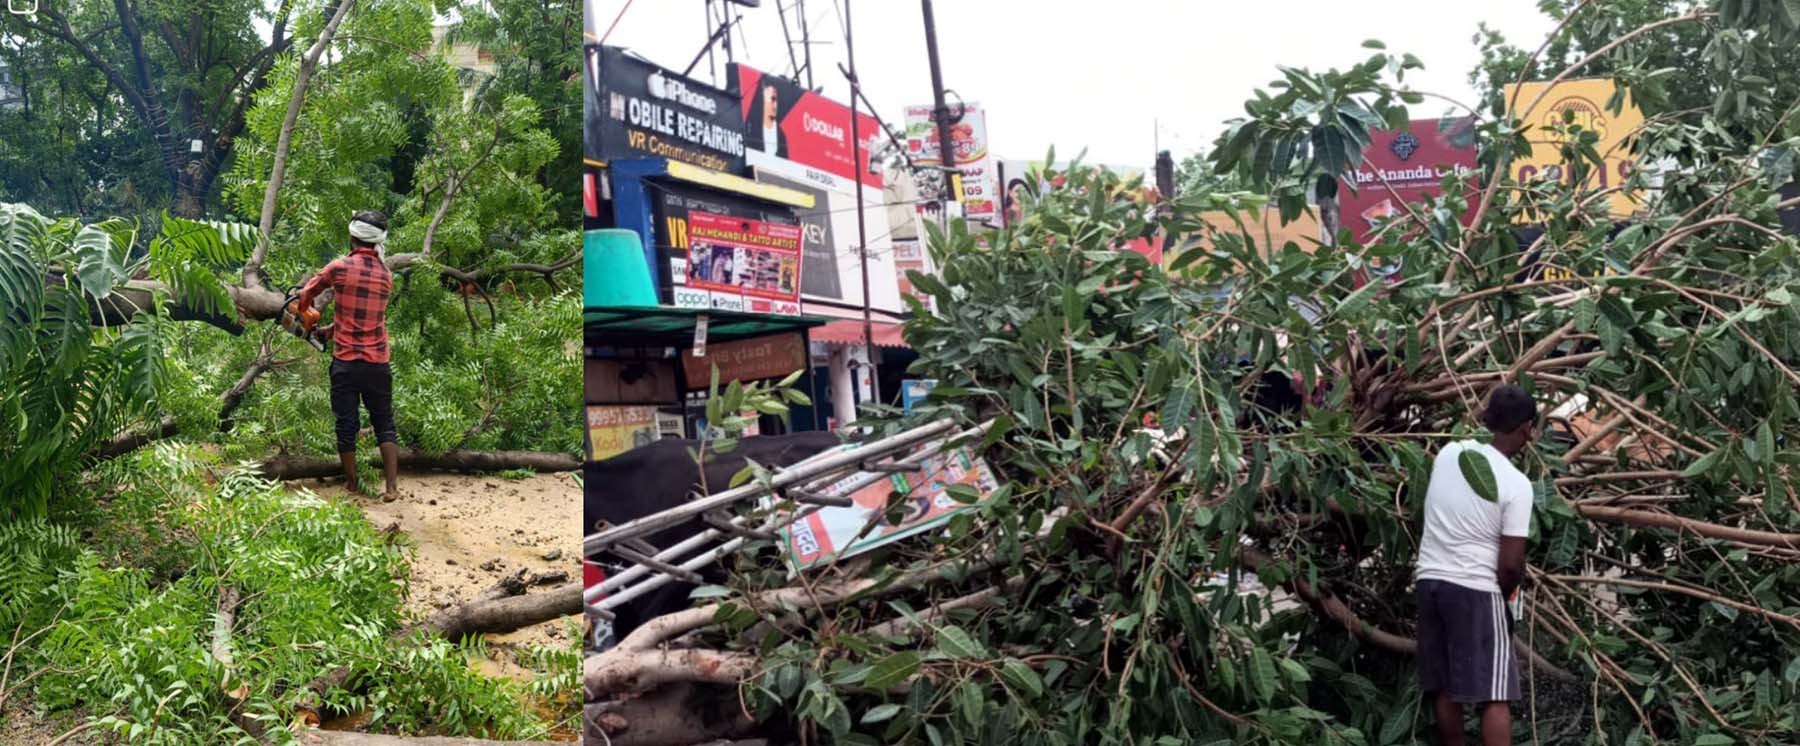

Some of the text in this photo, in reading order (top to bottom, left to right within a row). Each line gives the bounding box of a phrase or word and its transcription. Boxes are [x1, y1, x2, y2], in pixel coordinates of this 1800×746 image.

[667, 78, 717, 114] iPhone
[628, 129, 646, 150] VR
[678, 112, 744, 157] REPAIRING
[812, 118, 844, 141] DOLLAR
[1377, 164, 1432, 182] Ananda
[666, 216, 688, 249] VR
[772, 239, 797, 249] ARTIST
[802, 222, 827, 245] KEY
[775, 304, 798, 314] LAVA
